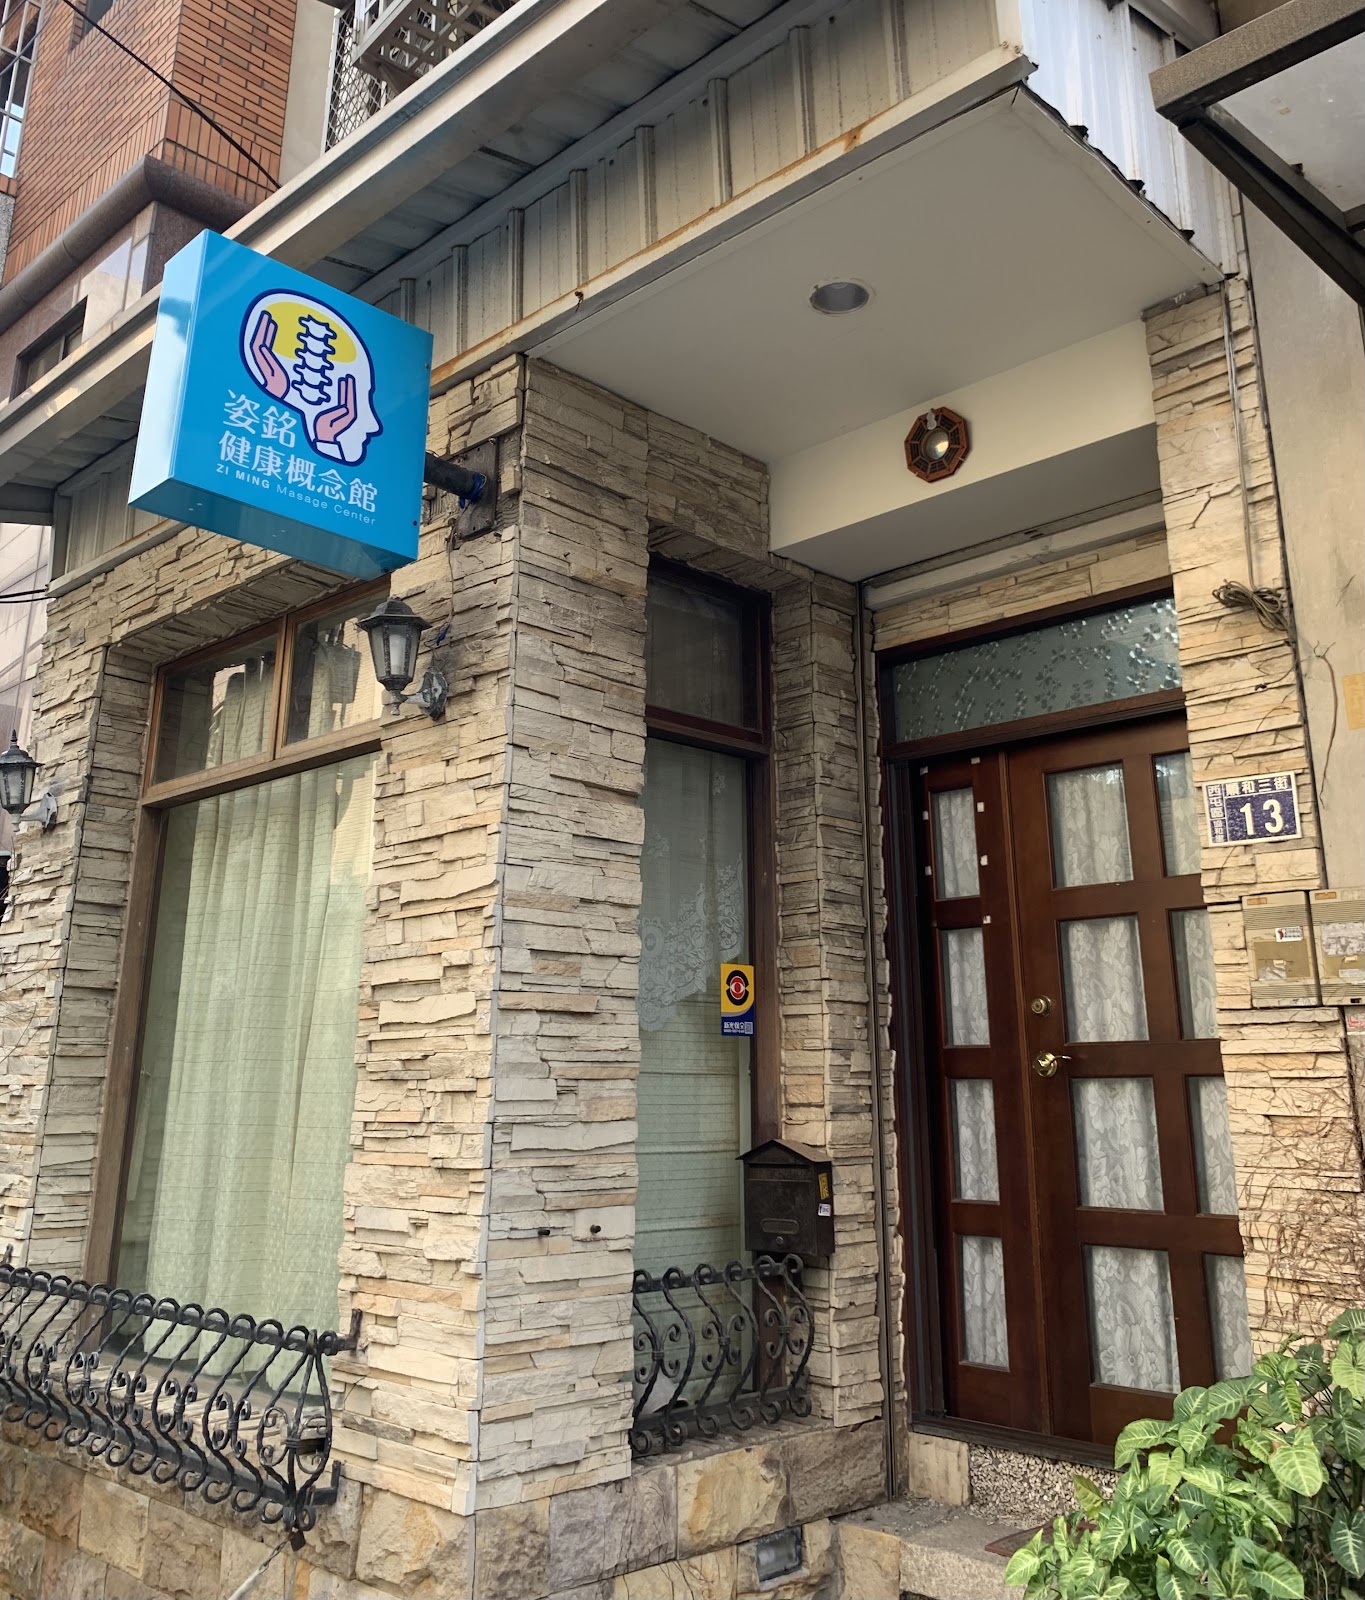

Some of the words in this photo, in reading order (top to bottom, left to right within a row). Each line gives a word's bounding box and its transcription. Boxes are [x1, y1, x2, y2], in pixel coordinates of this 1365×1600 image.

[223, 389, 297, 448] 姿銘
[216, 463, 229, 475] ZI
[235, 470, 270, 489] MING
[276, 484, 328, 510] Masage
[334, 504, 377, 526] Center
[218, 430, 378, 513] 健康概念館
[1240, 799, 1284, 836] 13
